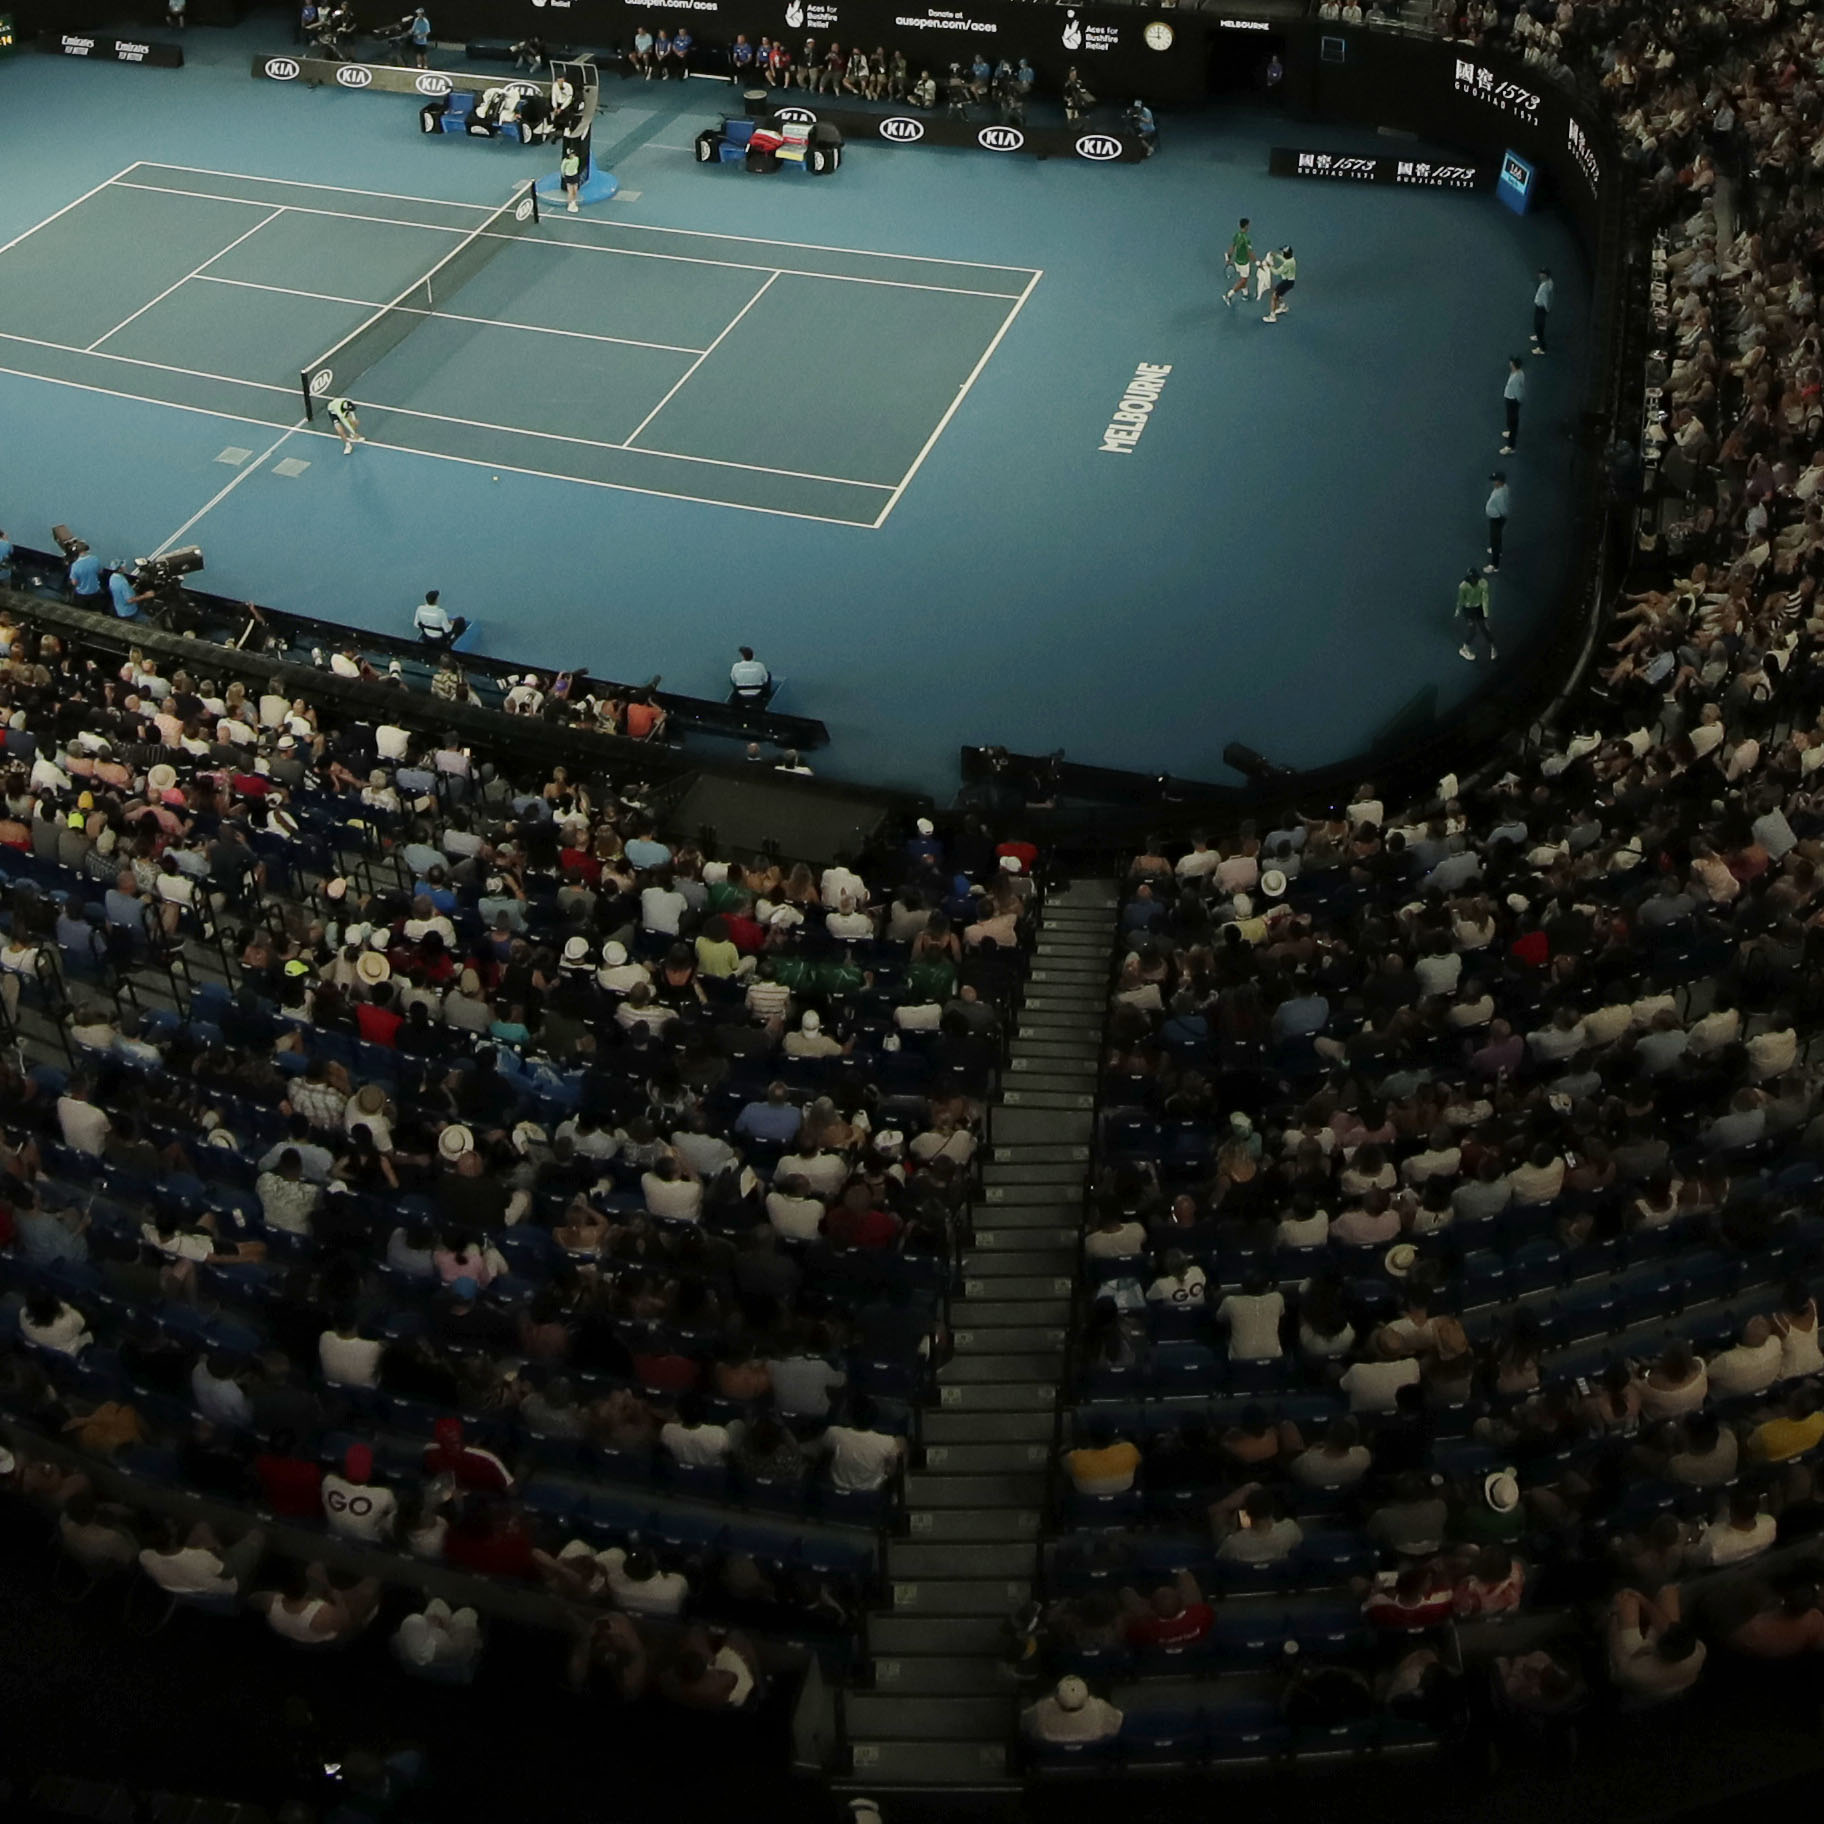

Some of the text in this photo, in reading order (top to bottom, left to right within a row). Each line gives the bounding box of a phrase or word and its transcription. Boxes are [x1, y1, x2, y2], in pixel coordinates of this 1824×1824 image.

[895, 15, 997, 33] ausopen.com/aces
[1085, 25, 1119, 35] Aces for
[1220, 20, 1269, 30] MELBOURNE
[61, 35, 95, 48] Emirates
[1085, 33, 1119, 44] Bushfire
[115, 40, 150, 55] Emirates
[1085, 41, 1109, 51] Relief
[1098, 362, 1173, 455] MELBOURNE
[1172, 1282, 1203, 1303] GO
[328, 1490, 373, 1517] GO
